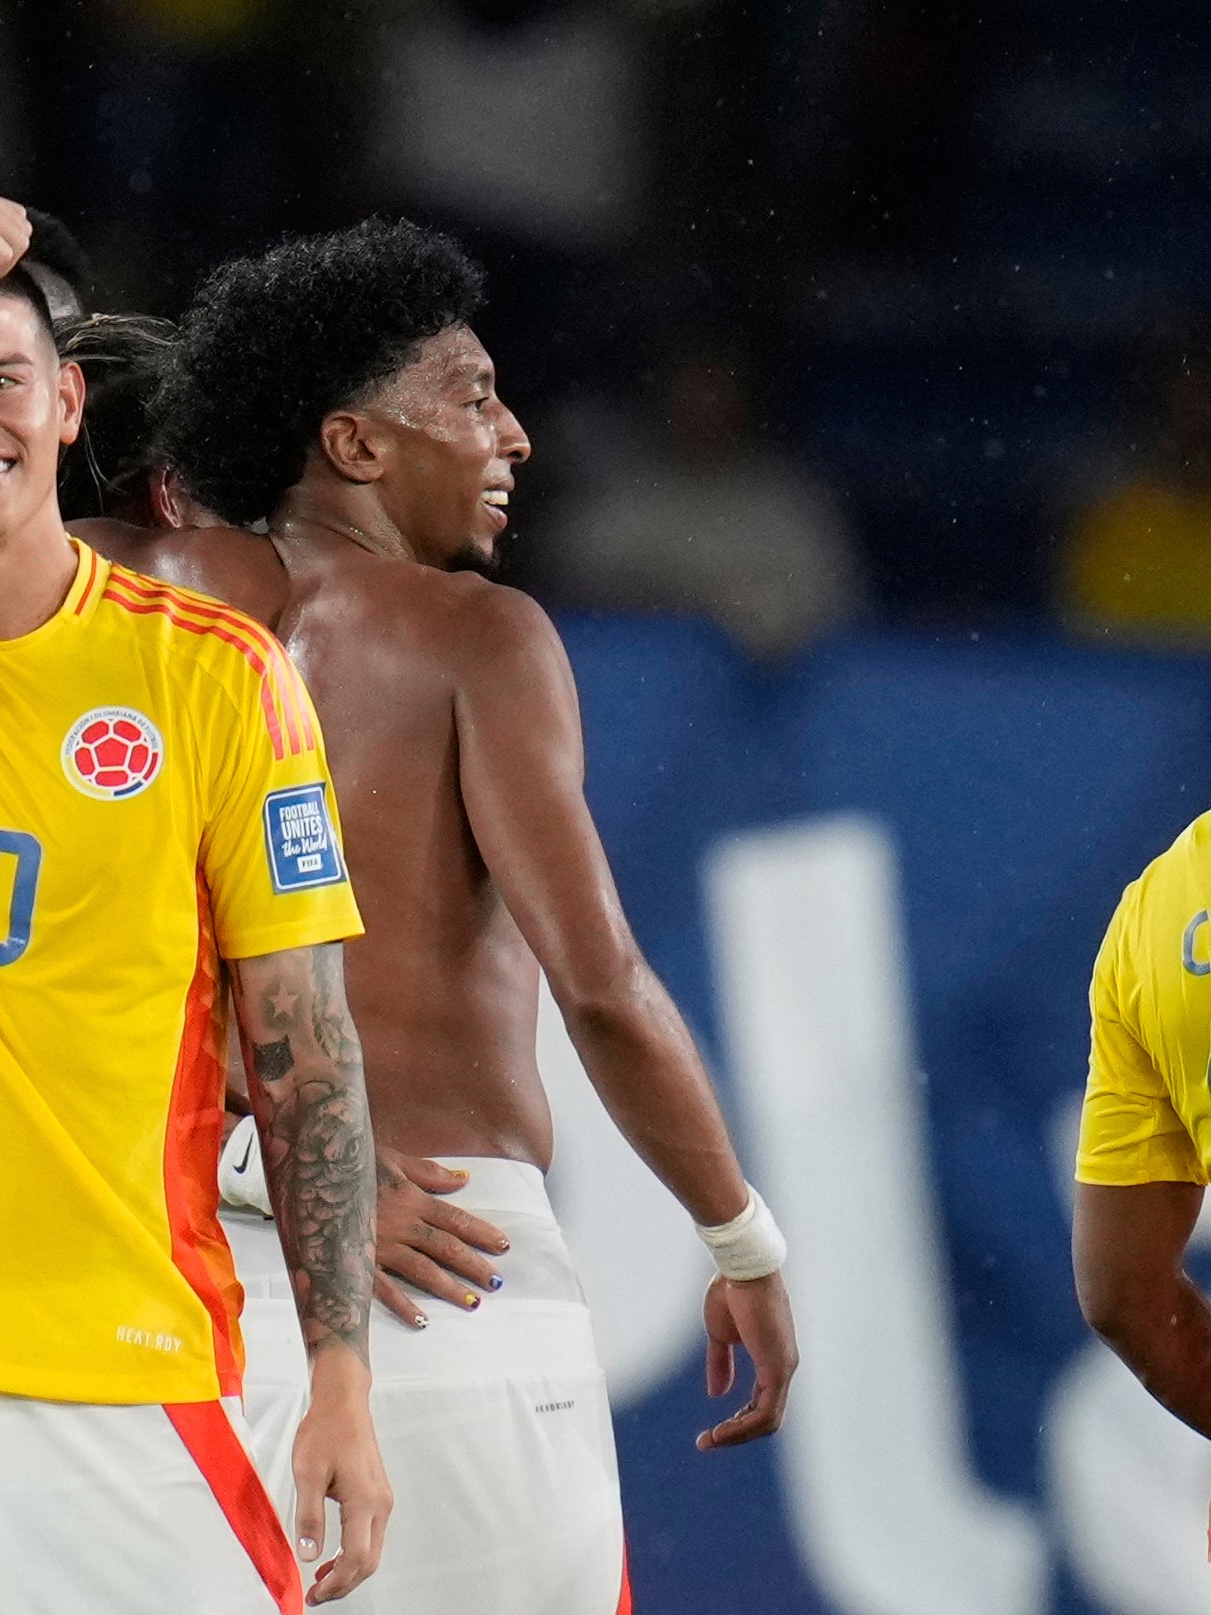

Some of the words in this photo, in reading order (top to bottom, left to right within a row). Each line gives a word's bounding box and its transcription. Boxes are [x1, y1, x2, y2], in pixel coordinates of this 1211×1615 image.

[279, 801, 321, 821] FOOTBALL
[281, 815, 324, 840] UNITES
[281, 840, 302, 858] the
[301, 832, 328, 854] World
